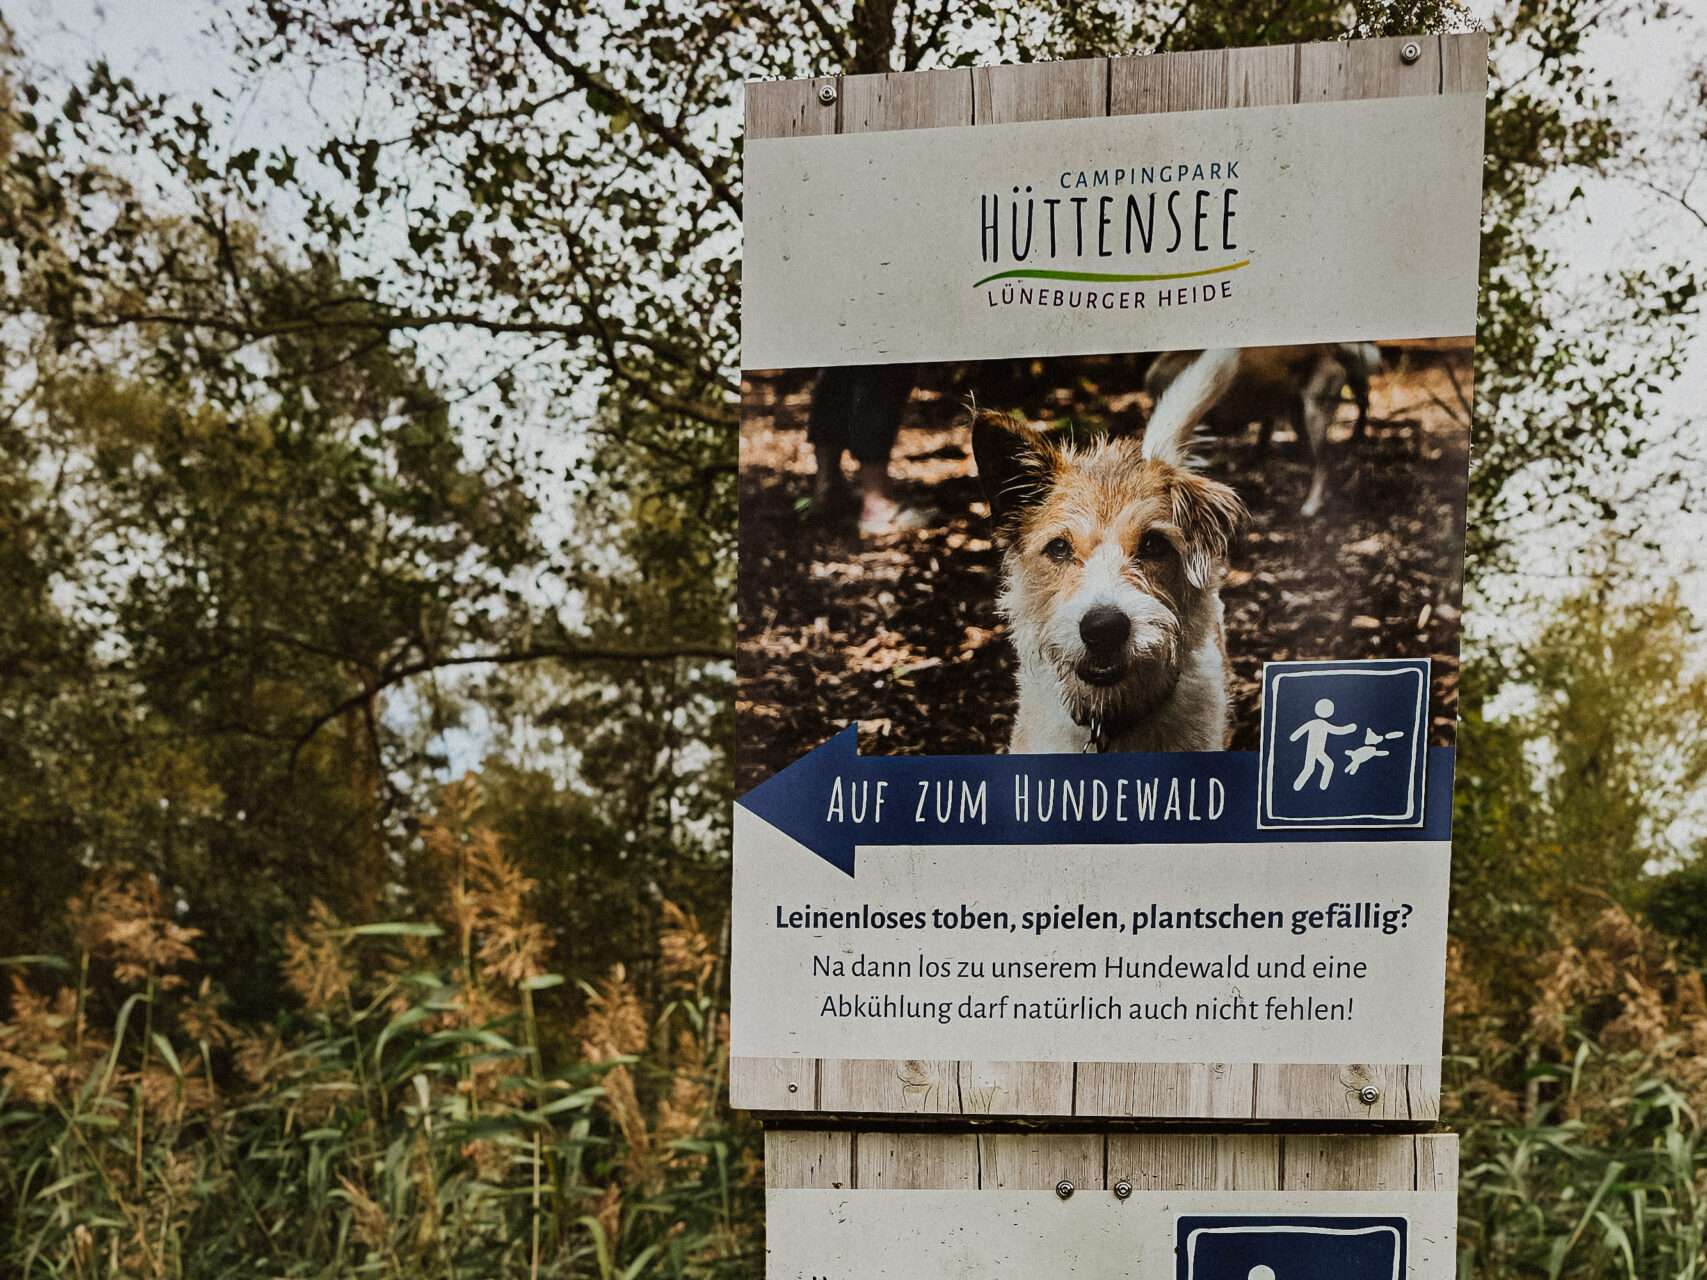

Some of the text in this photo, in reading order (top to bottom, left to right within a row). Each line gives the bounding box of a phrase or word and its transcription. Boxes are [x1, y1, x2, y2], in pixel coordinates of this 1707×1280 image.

[1060, 160, 1240, 189] CAMPINGPARK
[981, 185, 1239, 263] HÜTTENSEE
[988, 280, 1233, 310] LÜNEBURGER HEIDE
[774, 902, 1414, 935] Leinenloses toben, spielen, plantschen gefällig?
[812, 954, 1368, 980] Na dann los zu unserem Hundewald und eine
[819, 995, 1354, 1022] Abkühlung darf natürlich auch nicht fehlen!
